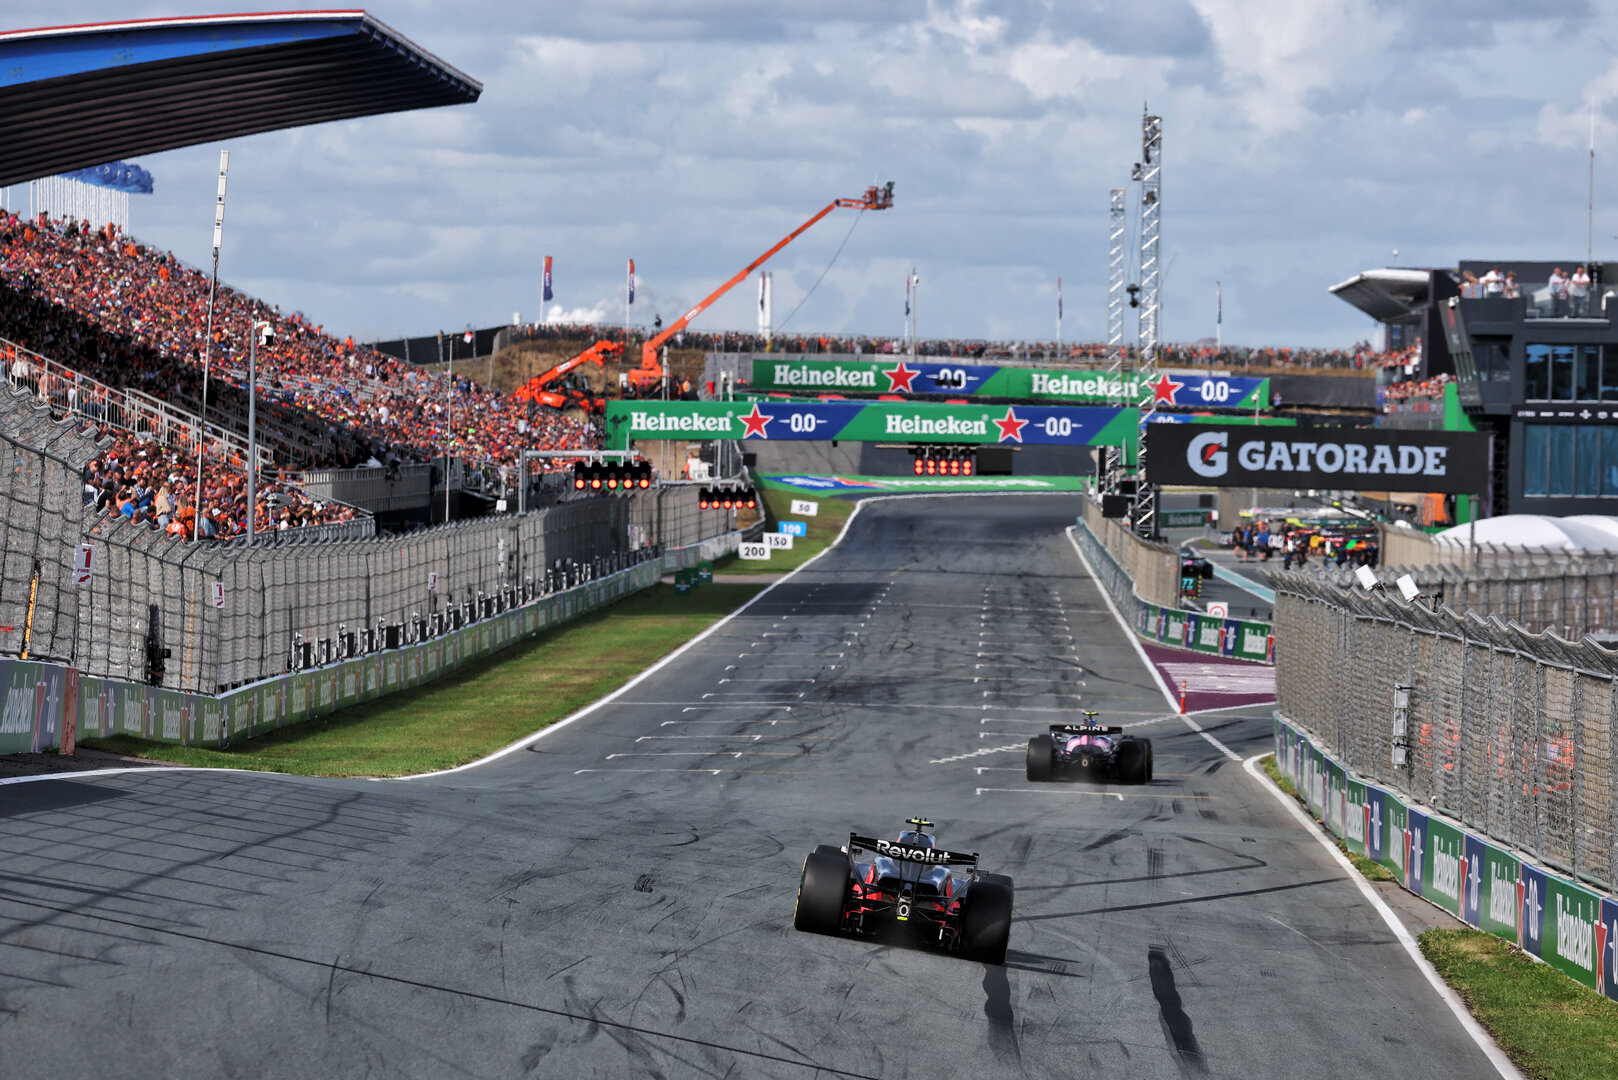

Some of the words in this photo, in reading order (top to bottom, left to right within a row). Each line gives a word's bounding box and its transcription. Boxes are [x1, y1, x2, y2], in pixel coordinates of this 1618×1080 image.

[774, 365, 876, 386] Heineken
[1032, 374, 1139, 398] Heineken
[1201, 381, 1229, 402] 0.0
[631, 412, 732, 431] Heineken
[791, 413, 816, 432] 0.0
[886, 415, 987, 435] Heineken
[1045, 417, 1071, 436] 0.0
[1186, 431, 1229, 477] G
[1238, 440, 1447, 476] GATORADE
[799, 504, 810, 512] 50
[783, 524, 801, 534] 100
[744, 547, 766, 556] 200
[769, 536, 787, 546] 150
[877, 840, 951, 864] Revolut
[1556, 892, 1593, 972] Heineken
